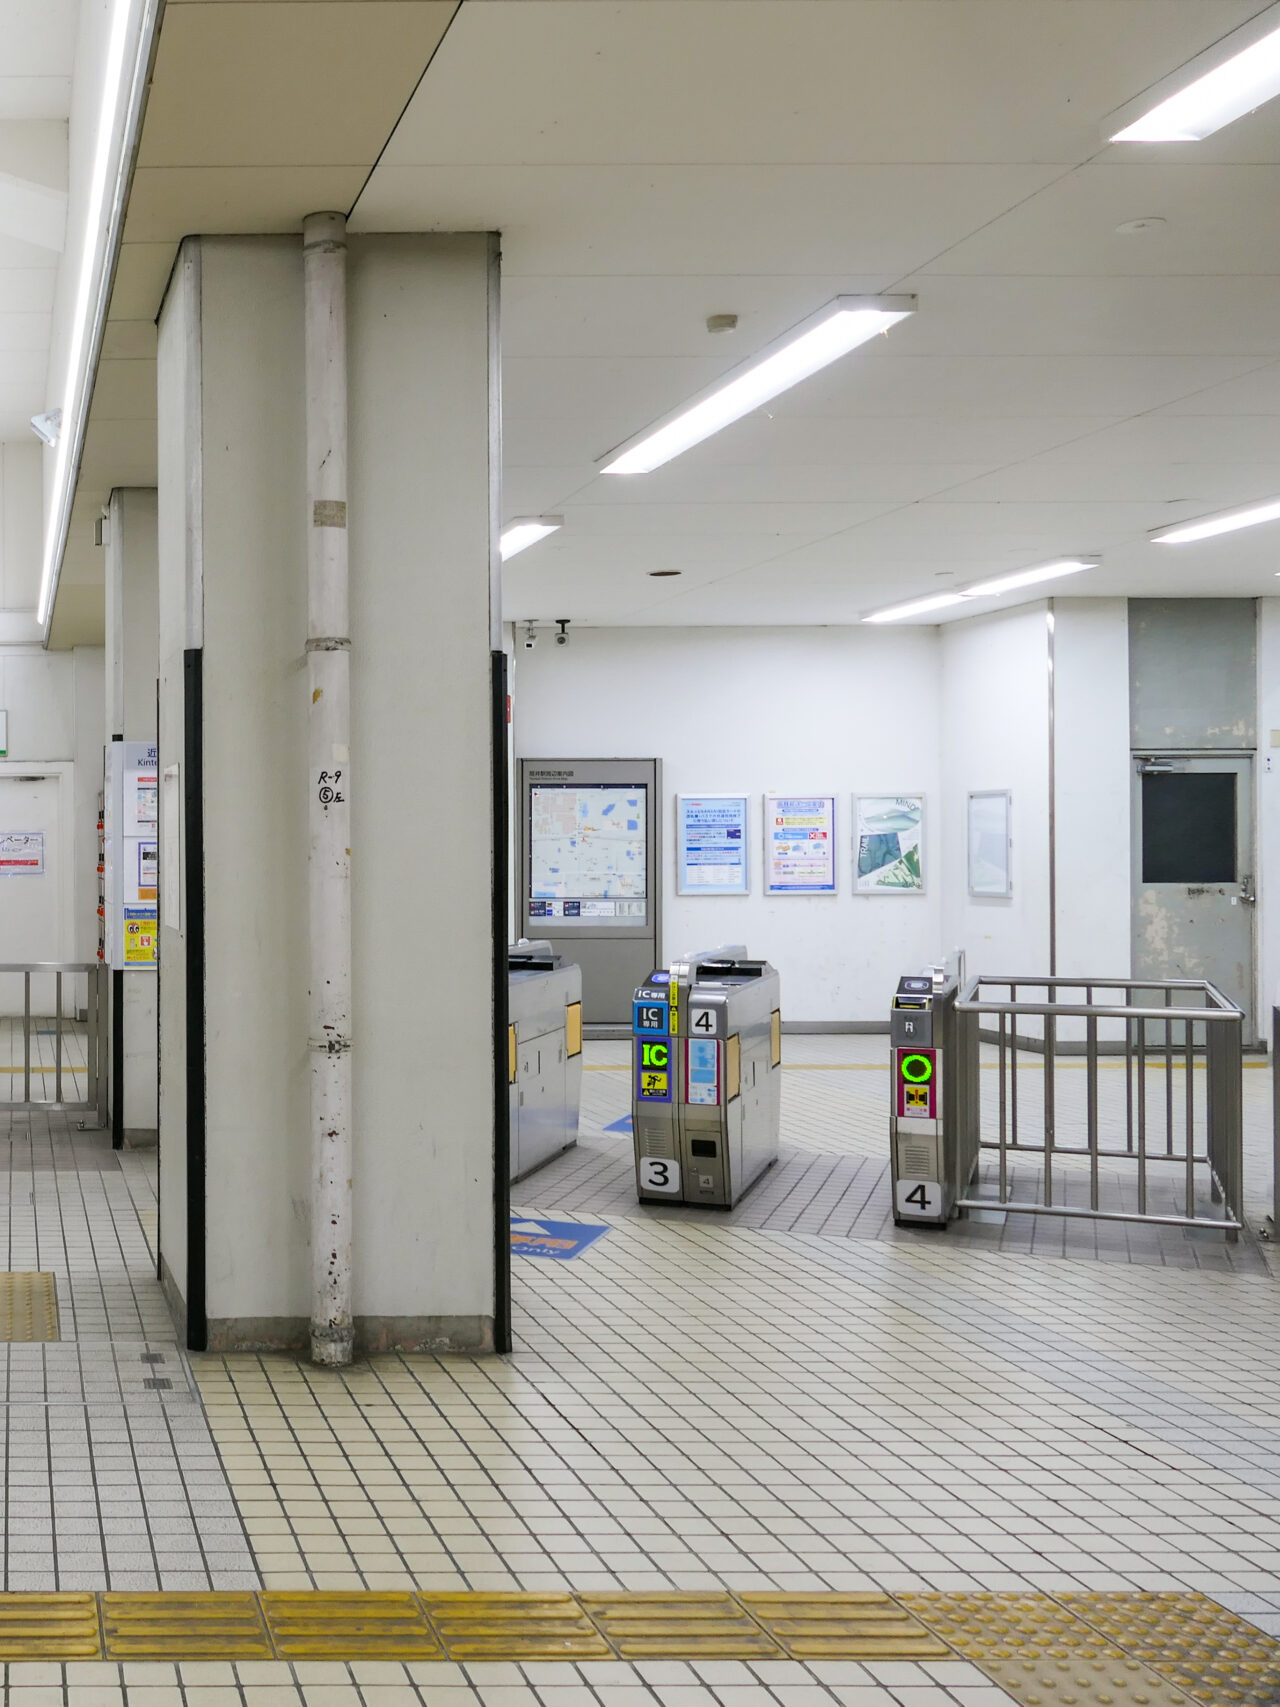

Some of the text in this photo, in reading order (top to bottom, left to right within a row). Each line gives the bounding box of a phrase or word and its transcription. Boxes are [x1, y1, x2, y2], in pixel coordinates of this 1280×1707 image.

[318, 770, 342, 784] R-9
[642, 1008, 658, 1020] IC
[695, 1011, 713, 1032] 4
[642, 1044, 668, 1066] IC
[648, 1161, 669, 1187] 3
[702, 1177, 710, 1185] 4
[905, 1184, 932, 1210] 4
